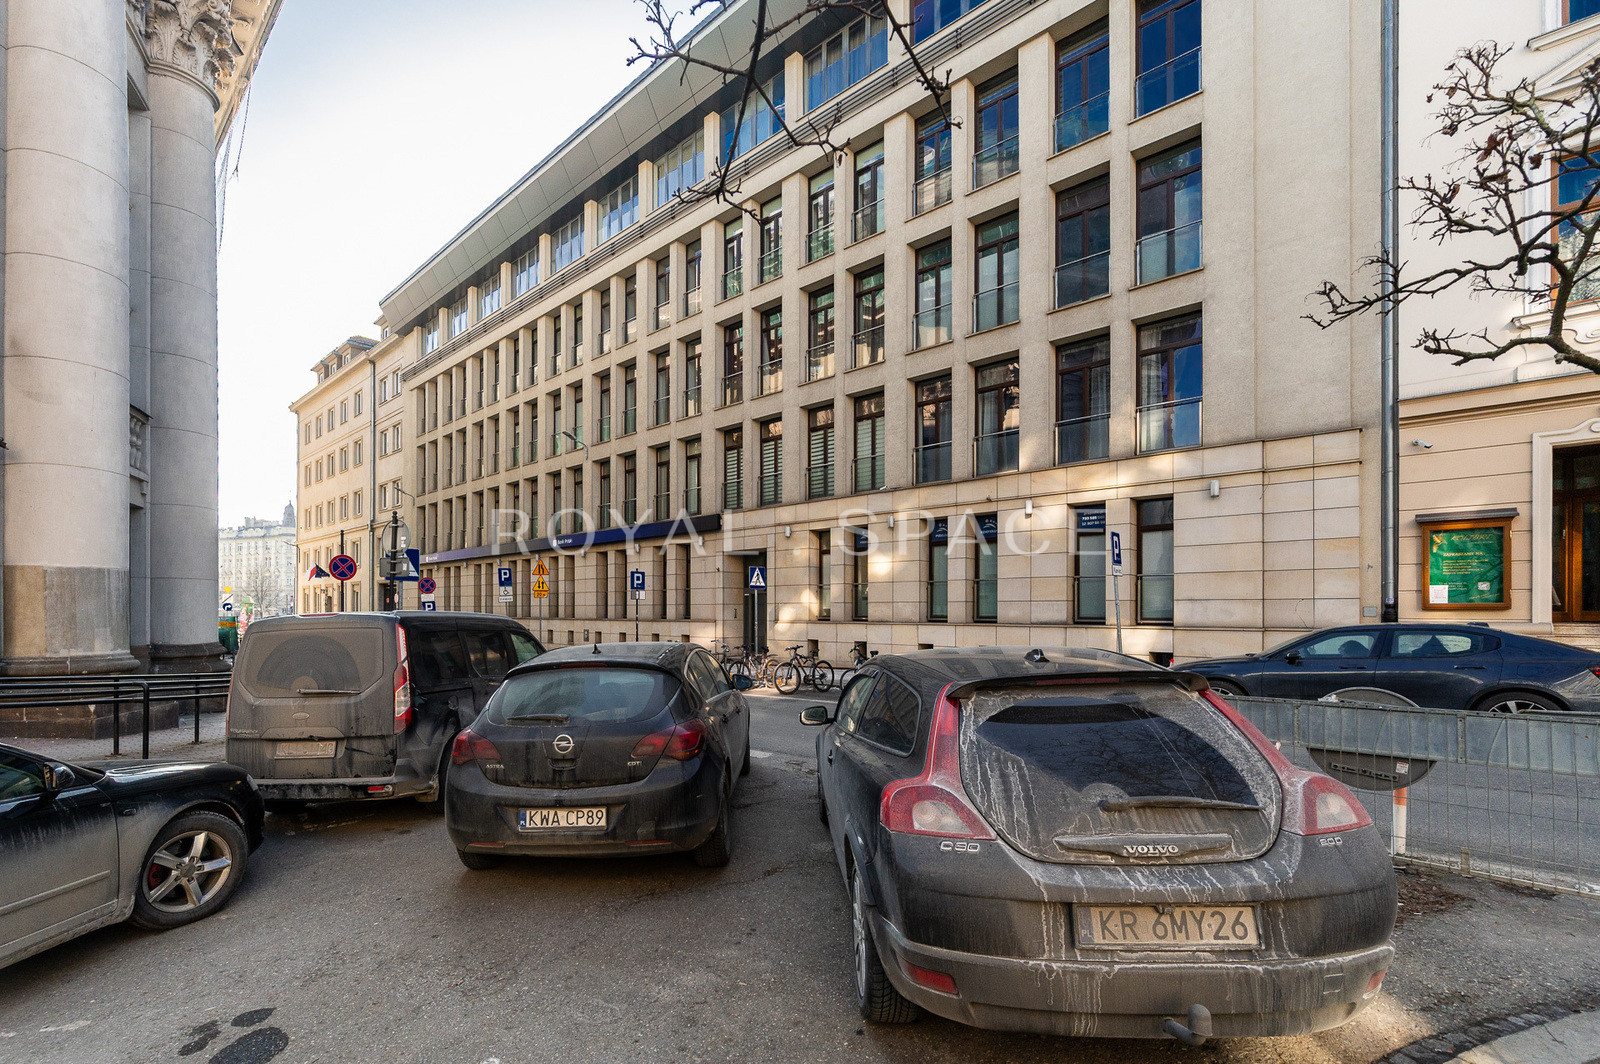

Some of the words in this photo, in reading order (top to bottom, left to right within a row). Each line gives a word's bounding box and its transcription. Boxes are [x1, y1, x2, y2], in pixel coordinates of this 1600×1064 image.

[1113, 535, 1119, 561] P
[501, 569, 510, 581] P
[634, 573, 643, 588] P
[425, 602, 433, 611] P
[528, 810, 561, 827] KWA
[566, 810, 604, 827] CP89
[940, 841, 980, 852] C30
[1123, 844, 1179, 854] VOLVO
[1081, 929, 1092, 938] PL
[1099, 910, 1140, 941] KR
[1152, 910, 1249, 941] 6MY26
